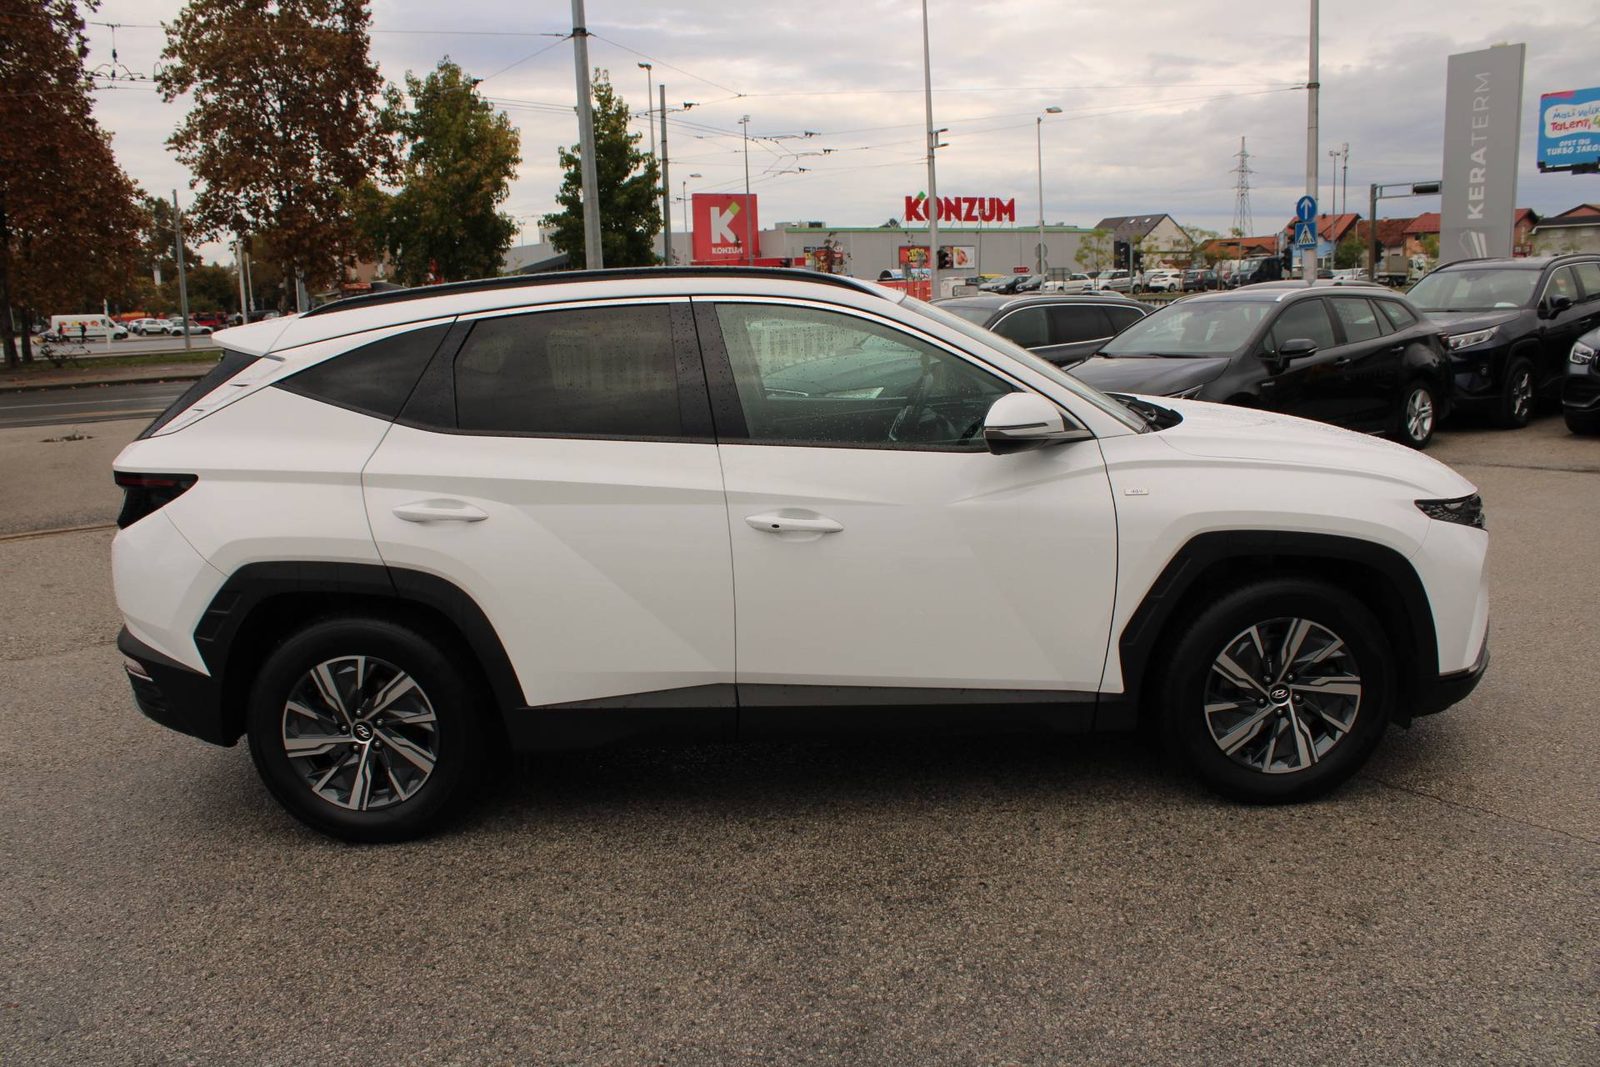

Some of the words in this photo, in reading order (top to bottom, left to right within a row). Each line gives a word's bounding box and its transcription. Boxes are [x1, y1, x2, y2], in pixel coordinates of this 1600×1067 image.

[1467, 72, 1491, 220] KERATERM
[1546, 146, 1574, 156] TURBO
[905, 191, 1015, 222] KONZUM
[710, 202, 741, 244] K
[711, 246, 744, 254] KONZUM
